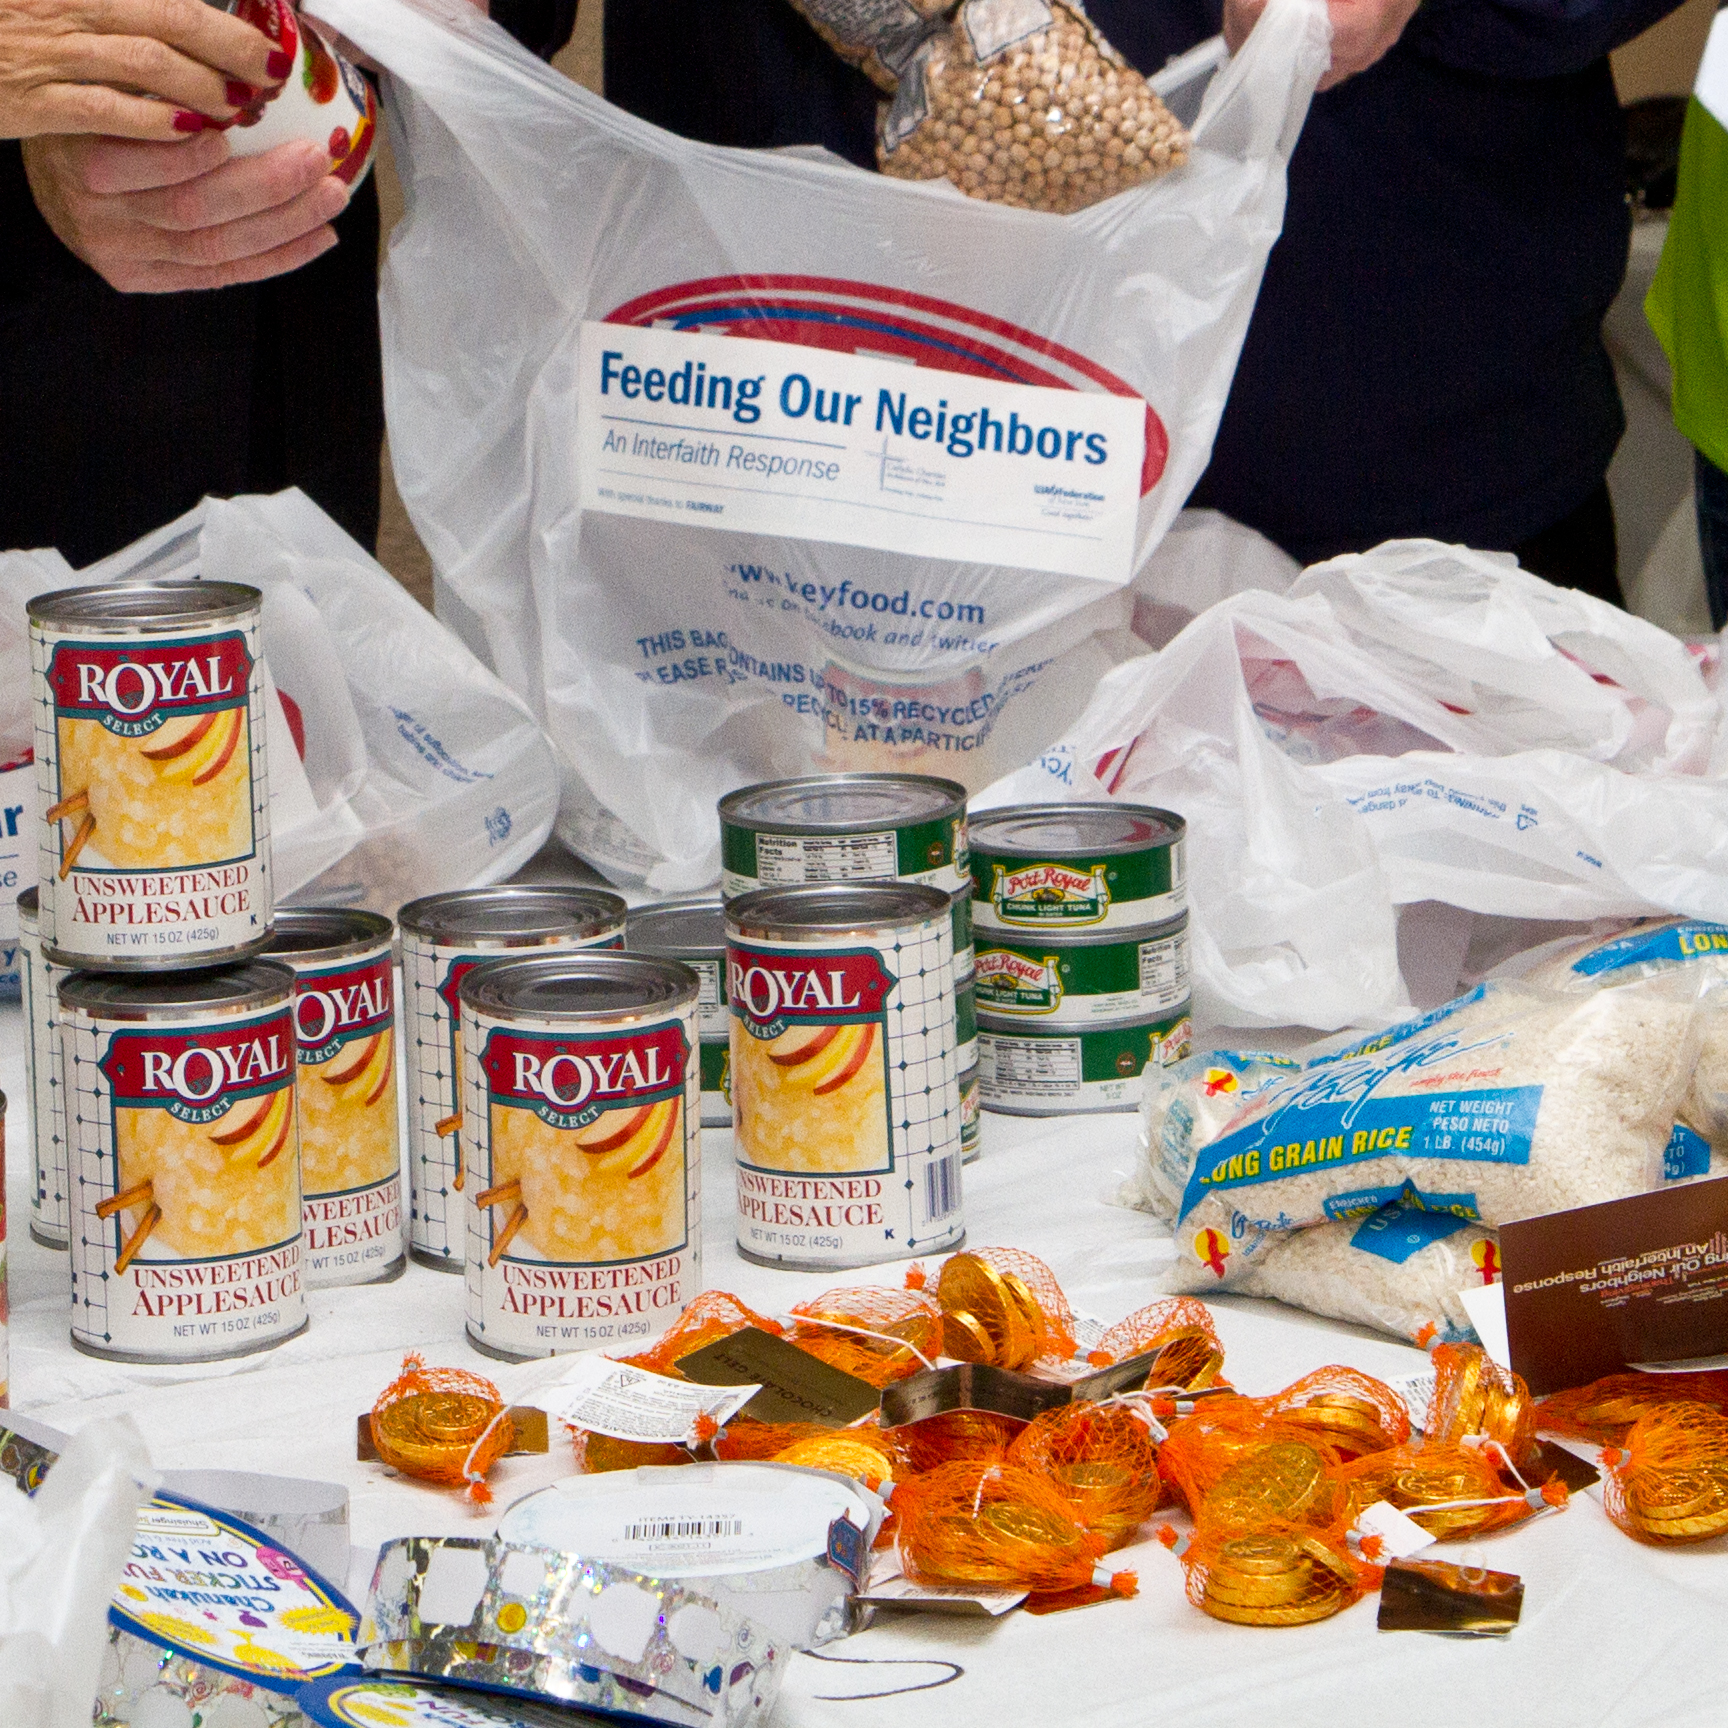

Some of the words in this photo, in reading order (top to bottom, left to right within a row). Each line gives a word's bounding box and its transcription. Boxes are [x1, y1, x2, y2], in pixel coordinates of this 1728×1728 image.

[601, 350, 766, 423] Feeding
[779, 373, 862, 425] Our
[875, 388, 1108, 465] Neighbors
[602, 429, 627, 454] An
[632, 433, 719, 468] Interfaith
[726, 444, 840, 481] Response
[883, 631, 922, 649] and
[78, 656, 234, 714] ROYAL
[636, 628, 686, 660] THIS
[849, 694, 889, 721] 15%
[103, 713, 163, 736] SELECT
[759, 838, 797, 847] Nutrition
[759, 847, 783, 856] Facts
[73, 865, 249, 898] UNSWEETENED
[1008, 871, 1043, 895] Port
[1044, 867, 1092, 891] Royal
[72, 889, 250, 926] APPLESAUCE
[1006, 903, 1036, 912] CHUNK
[1037, 903, 1065, 912] LIGHT
[1066, 903, 1092, 912] TUNA
[107, 931, 130, 945] NET
[131, 930, 151, 944] WT
[154, 930, 166, 944] 15
[167, 929, 184, 944] OZ
[185, 927, 220, 945] (425g)
[999, 954, 1043, 981] Royal
[731, 960, 861, 1018] ROYAL
[295, 976, 390, 1042] OYAL
[142, 1035, 289, 1100] ROYAL
[512, 1046, 670, 1107] ROYAL
[171, 1098, 233, 1121] SELECT
[537, 1106, 600, 1128] SELECT
[1429, 1100, 1456, 1114] NET
[1459, 1101, 1515, 1115] WEIGHT
[1433, 1117, 1468, 1131] PESO
[1472, 1119, 1510, 1134] NETO
[1200, 1153, 1261, 1184] ONG
[1269, 1134, 1344, 1172] GRAIN
[1352, 1126, 1415, 1156] RICE
[1461, 1137, 1506, 1155] (454g)
[750, 1229, 765, 1241] NET
[765, 1230, 778, 1243] WT
[779, 1233, 790, 1246] 15
[790, 1234, 806, 1246] OZ
[809, 1235, 843, 1249] (425g)
[884, 1228, 895, 1240] K
[312, 1257, 332, 1269] WT
[333, 1254, 346, 1267] 15
[346, 1252, 360, 1265] OZ
[1600, 1247, 1681, 1275] Interfaith
[1687, 1243, 1708, 1255] An
[133, 1244, 301, 1289] UNSWEETENED
[502, 1256, 682, 1290] UNSWEETENED
[1580, 1266, 1665, 1293] Neighbors
[1671, 1259, 1700, 1274] Our
[131, 1269, 302, 1318] APPLESAUCE
[1513, 1269, 1597, 1294] Response
[500, 1280, 682, 1318] APPLESAUCE
[173, 1322, 196, 1338] NET
[198, 1321, 219, 1337] WT
[223, 1319, 235, 1334] 15
[236, 1317, 252, 1333] OZ
[252, 1310, 282, 1333] (425g)
[536, 1325, 557, 1337] NET
[560, 1326, 579, 1338] WT
[583, 1326, 596, 1338] 15
[597, 1325, 614, 1338] OZ
[616, 1322, 651, 1338] (425g)
[712, 1351, 750, 1378] GELT
[167, 1547, 188, 1563] A
[199, 1550, 247, 1568] ON
[166, 1567, 281, 1592] STICKER
[145, 1585, 276, 1613] Chanukah
